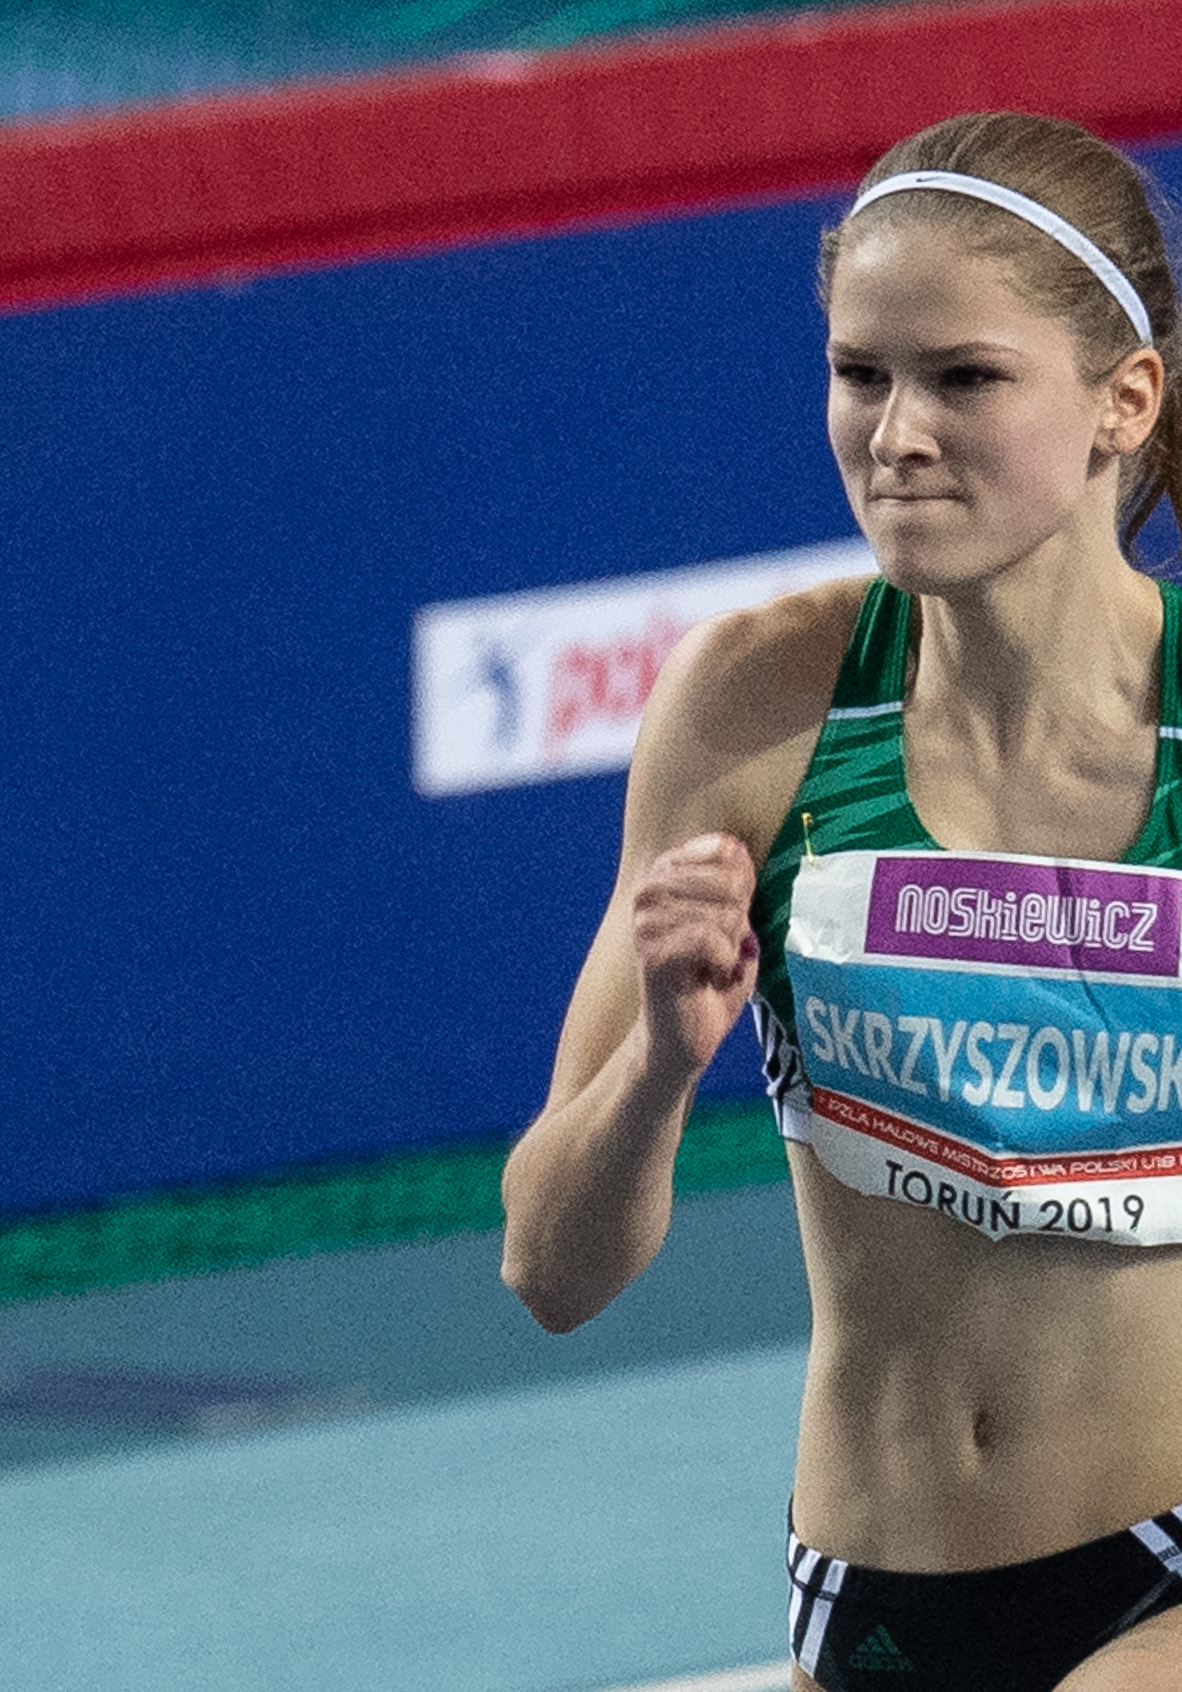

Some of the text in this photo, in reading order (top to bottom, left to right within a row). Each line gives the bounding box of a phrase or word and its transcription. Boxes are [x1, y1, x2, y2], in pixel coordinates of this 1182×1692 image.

[895, 884, 1158, 952] noskiewicz
[827, 1098, 870, 1127] PZLA
[872, 1117, 940, 1155] HALOWE
[942, 1146, 1067, 1180] MISTRZOSTWA
[1069, 1158, 1137, 1175] POLSKI
[1142, 1156, 1176, 1170] U18
[886, 1160, 1145, 1233] TORUŃ 2019
